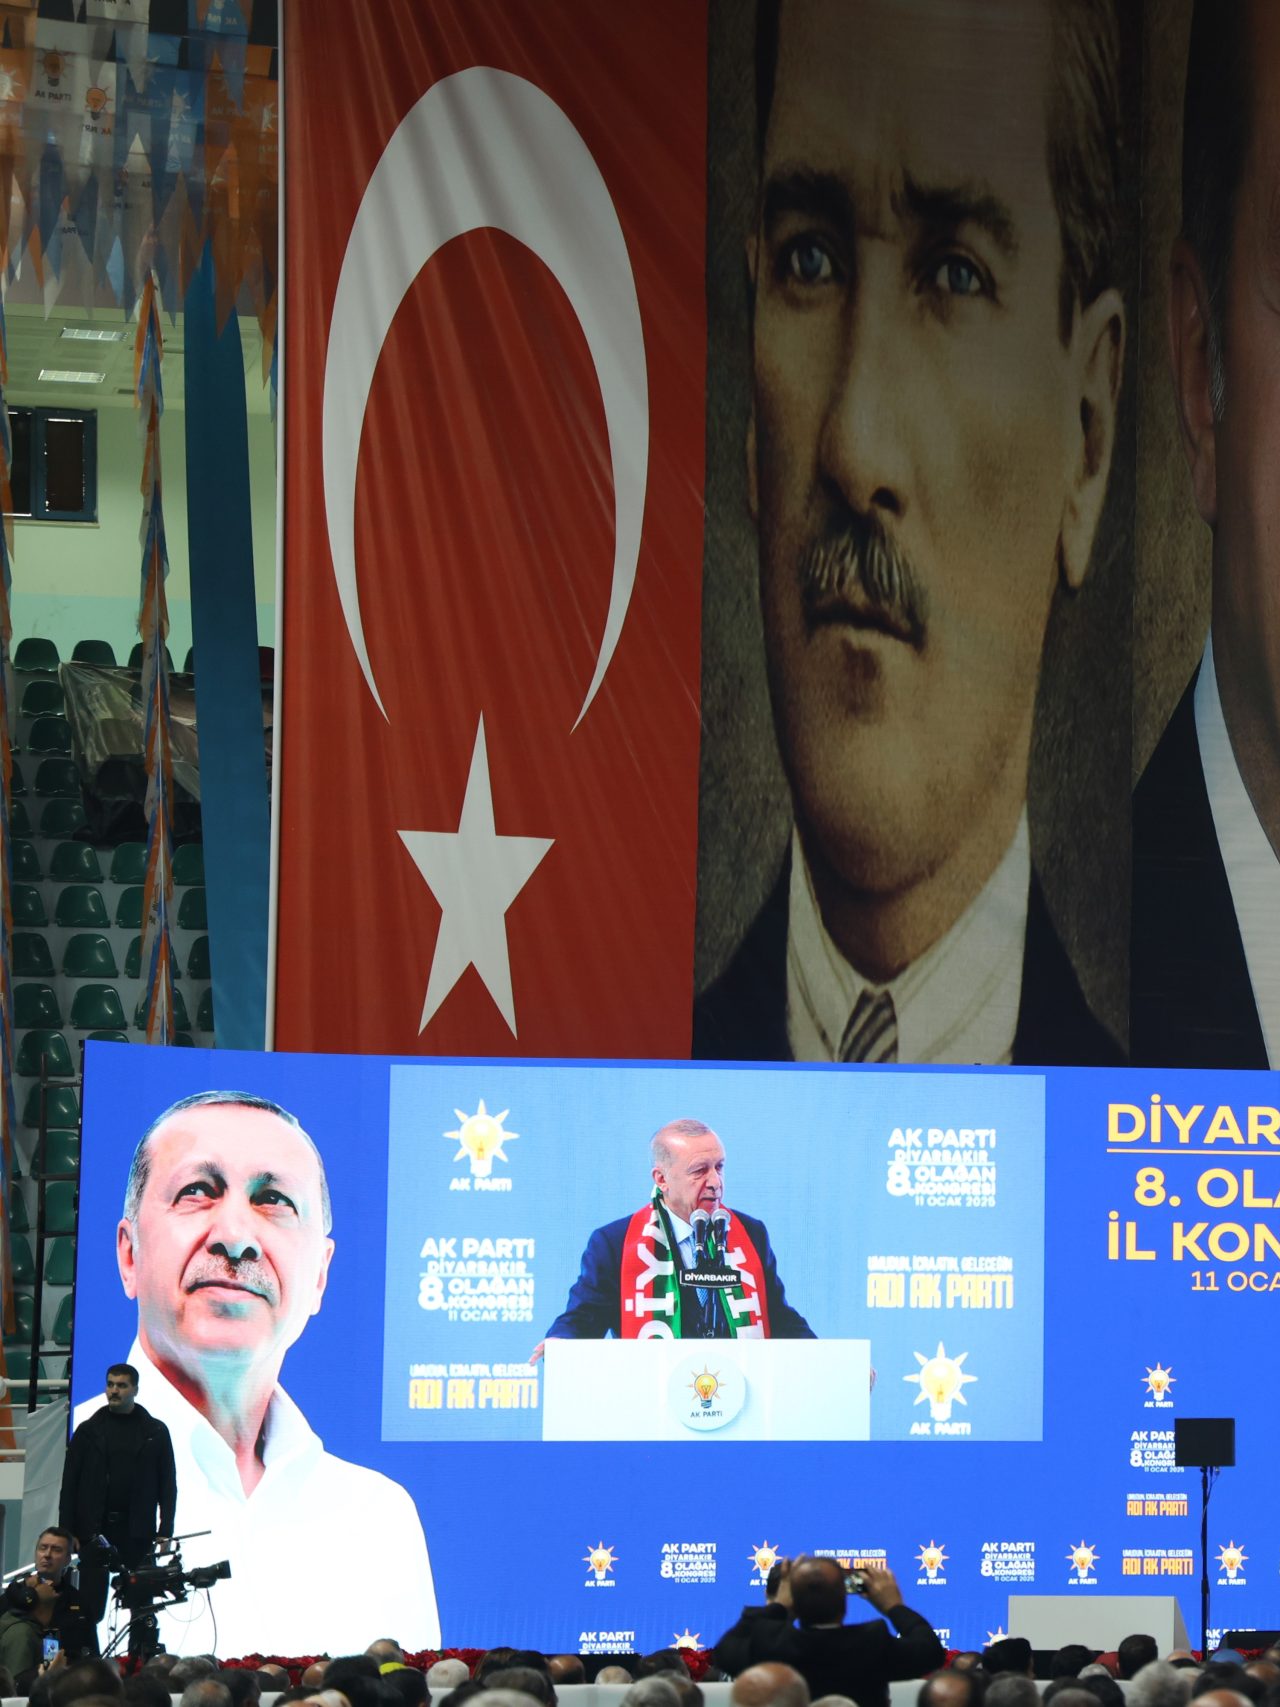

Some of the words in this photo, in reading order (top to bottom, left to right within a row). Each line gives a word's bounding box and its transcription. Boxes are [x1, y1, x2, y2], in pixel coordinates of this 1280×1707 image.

[888, 1128, 923, 1148] AK
[449, 1177, 471, 1191] AK
[1134, 1166, 1181, 1207] 8.
[1107, 1210, 1156, 1261] İL
[420, 1238, 457, 1259] AK
[684, 1272, 738, 1283] DİYARBAKIR
[1191, 1271, 1220, 1291] 11
[867, 1273, 905, 1309] ADI
[910, 1273, 942, 1310] AK
[409, 1378, 443, 1410] ADI
[447, 1378, 475, 1410] AK
[910, 1421, 931, 1436] AK
[1131, 1431, 1149, 1441] AK
[1150, 1431, 1176, 1441] PAR
[1145, 1501, 1158, 1516] AK
[661, 1543, 679, 1554] AK
[981, 1542, 999, 1552] AK
[1122, 1558, 1141, 1575] ADI
[1143, 1558, 1158, 1575] AK
[578, 1631, 597, 1642] AK
